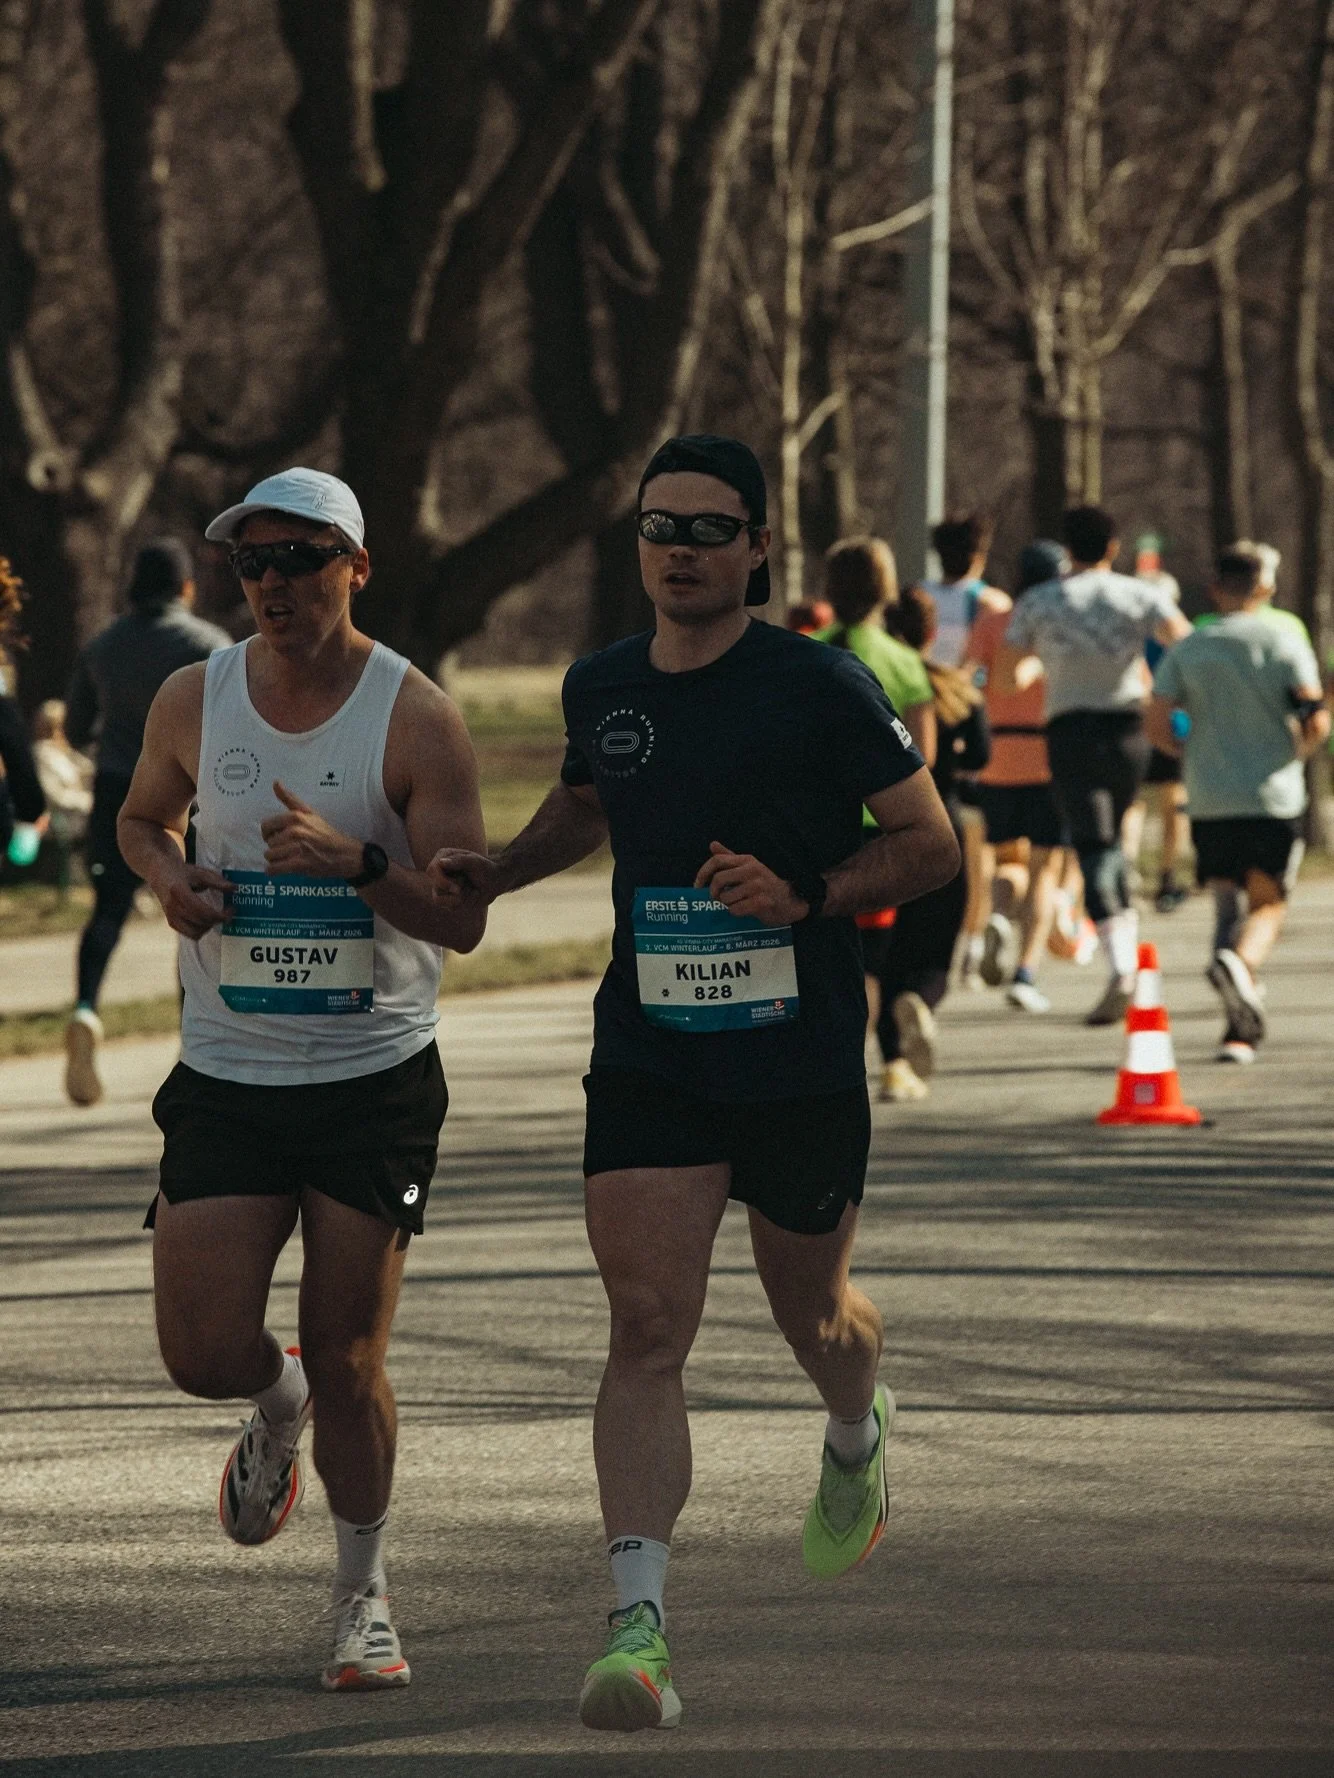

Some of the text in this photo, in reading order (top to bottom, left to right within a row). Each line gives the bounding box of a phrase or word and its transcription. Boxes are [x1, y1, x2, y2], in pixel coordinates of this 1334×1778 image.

[640, 714, 655, 763] RUNNING
[279, 885, 345, 897] SPARKASSE
[232, 895, 274, 908] Running
[645, 900, 676, 911] ERSTE
[646, 912, 689, 924] Running
[236, 927, 251, 935] VCM
[252, 928, 301, 936] WINTERLAUF
[670, 944, 717, 952] WINTERLAUF
[726, 942, 734, 950] 8.
[760, 938, 781, 946] 2026
[250, 945, 339, 965] GUSTAV
[273, 969, 311, 983] 987
[675, 959, 751, 981] KILIAN
[694, 985, 733, 1000] 828
